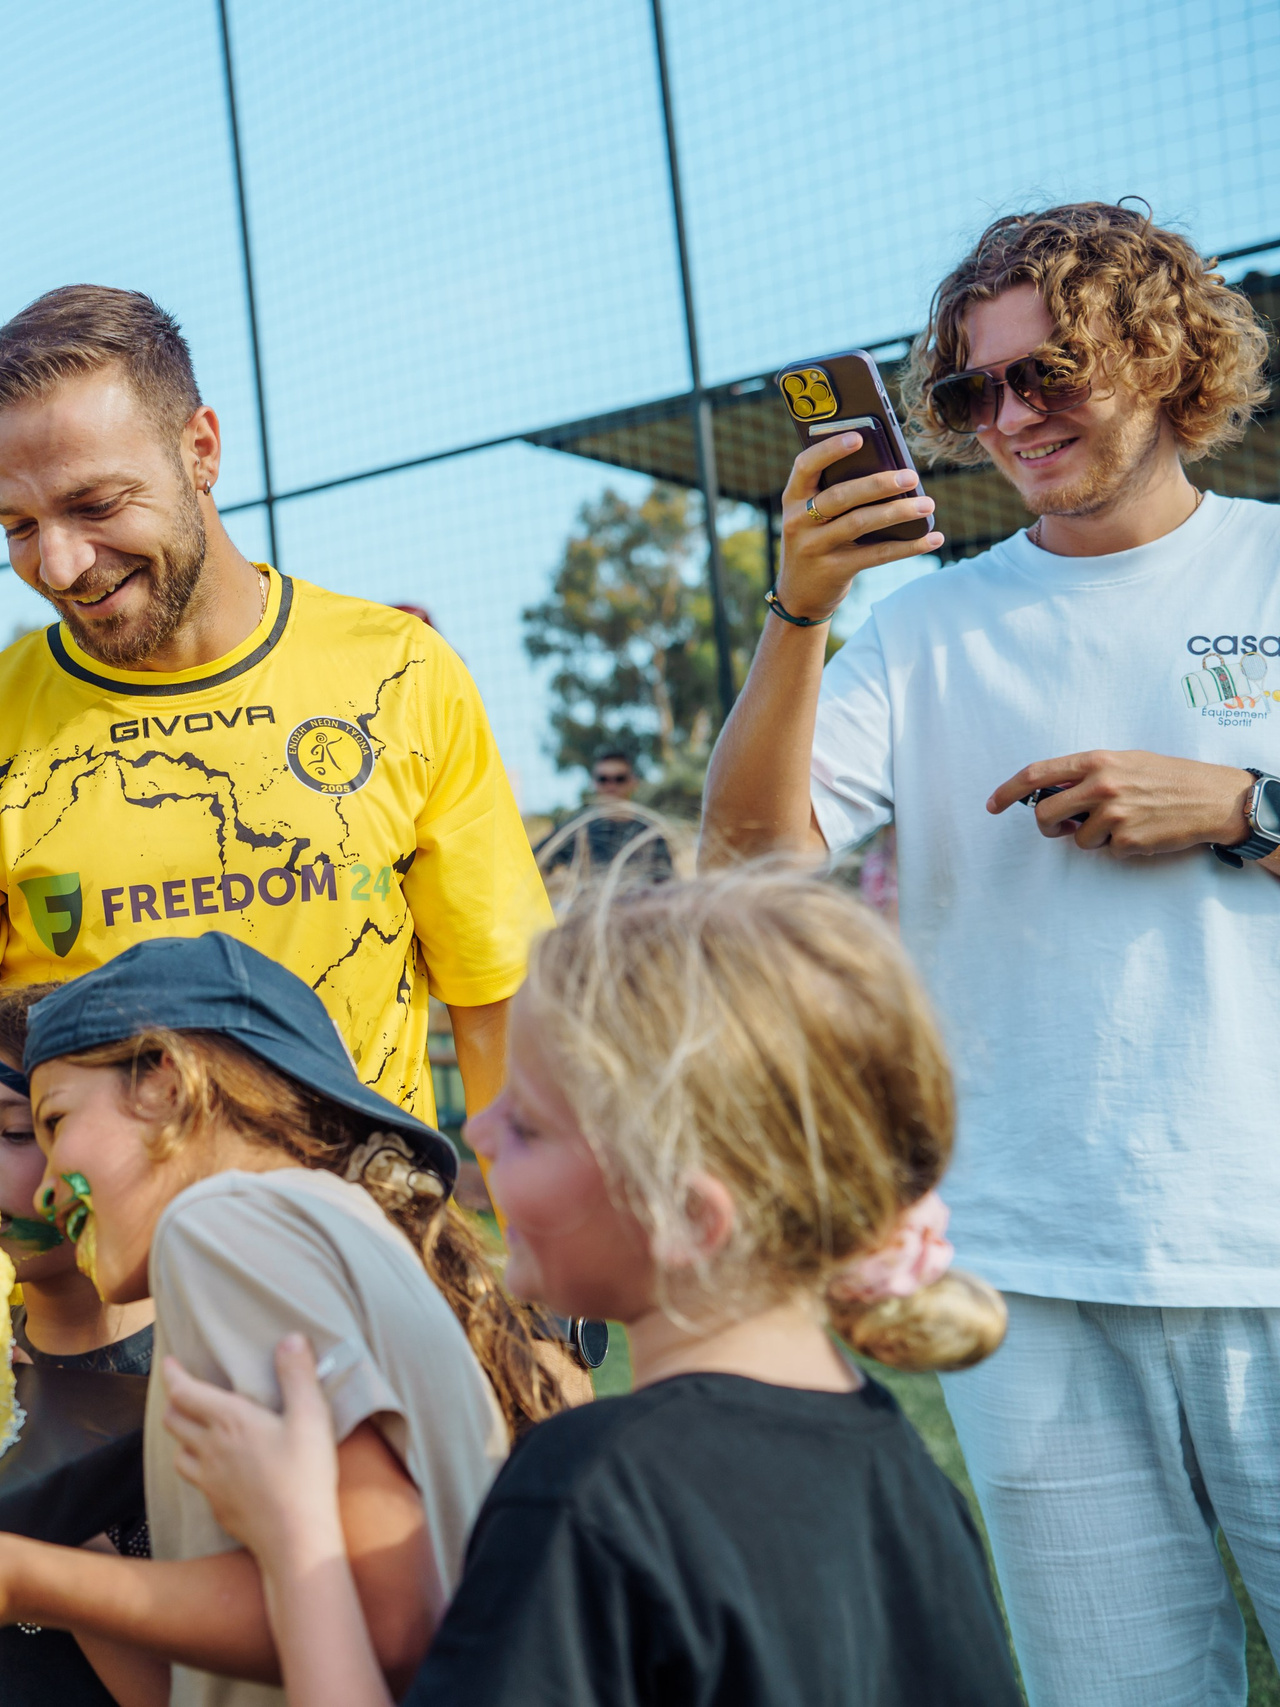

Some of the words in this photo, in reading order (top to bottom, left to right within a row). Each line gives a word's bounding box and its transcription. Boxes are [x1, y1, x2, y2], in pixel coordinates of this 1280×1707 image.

[109, 705, 276, 744] GIVOVA
[288, 726, 308, 755] ΕΝΩΣΗ
[309, 718, 339, 728] ΝΕΩΝ
[1217, 717, 1252, 728] Sportif
[320, 784, 351, 793] 2005
[101, 862, 339, 927] FREEDOM
[349, 864, 392, 902] 24
